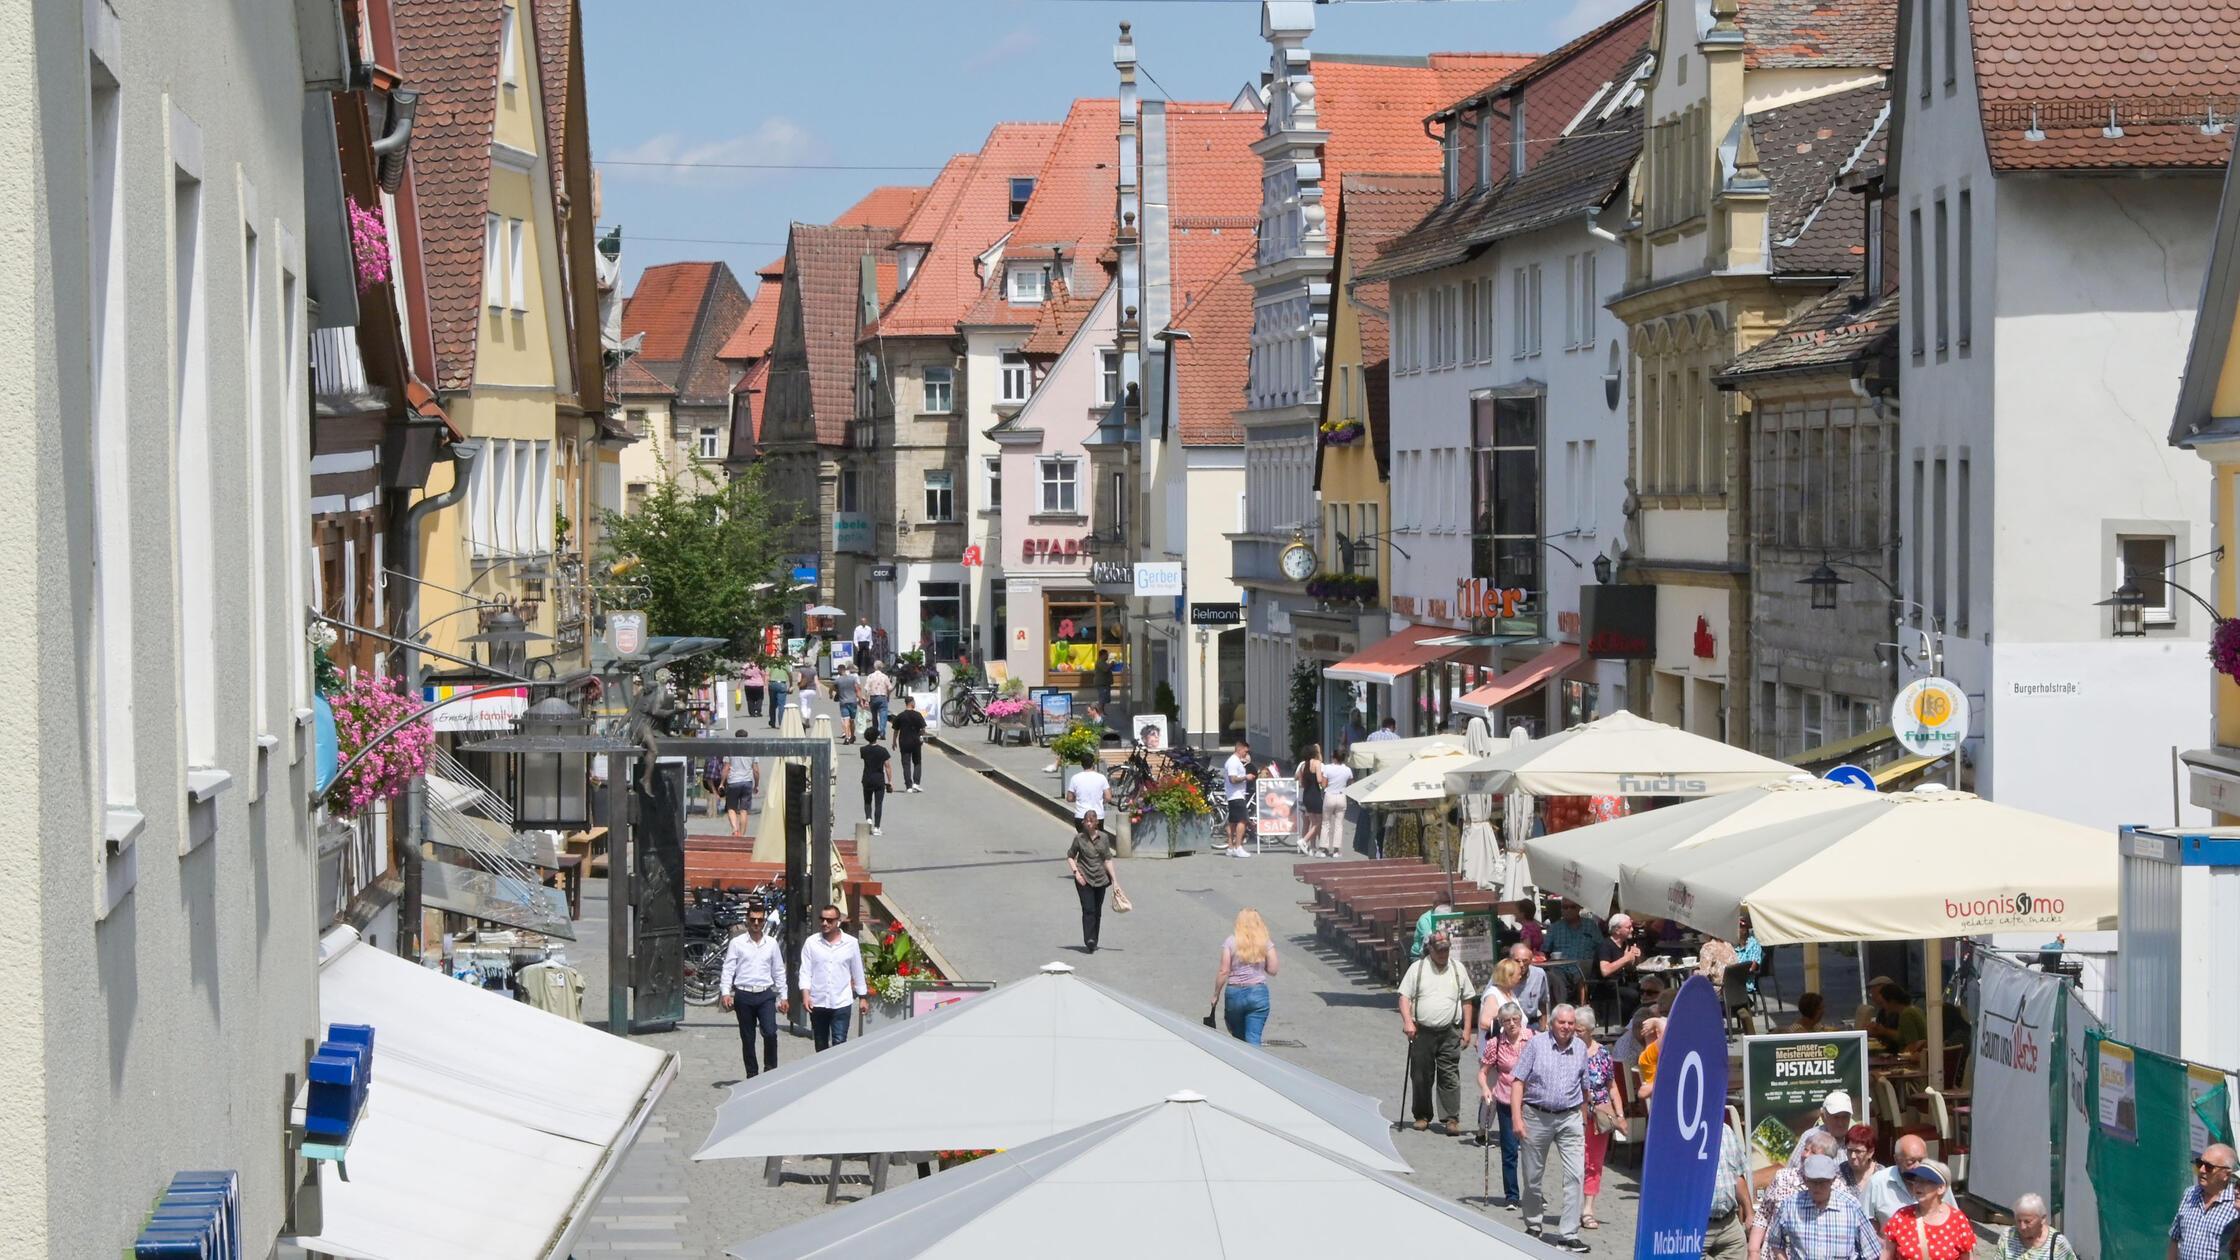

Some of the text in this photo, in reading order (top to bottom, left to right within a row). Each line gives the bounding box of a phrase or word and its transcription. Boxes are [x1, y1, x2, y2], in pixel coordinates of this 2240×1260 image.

[1138, 569, 1177, 589] Gerber
[480, 710, 513, 722] family
[1904, 730, 1957, 741] fuchs
[1617, 773, 1706, 793] fuchs
[1796, 1044, 1818, 1052] unser
[1776, 1049, 1823, 1060] Meisterwerk
[1776, 1060, 1836, 1077] PISTAZIE
